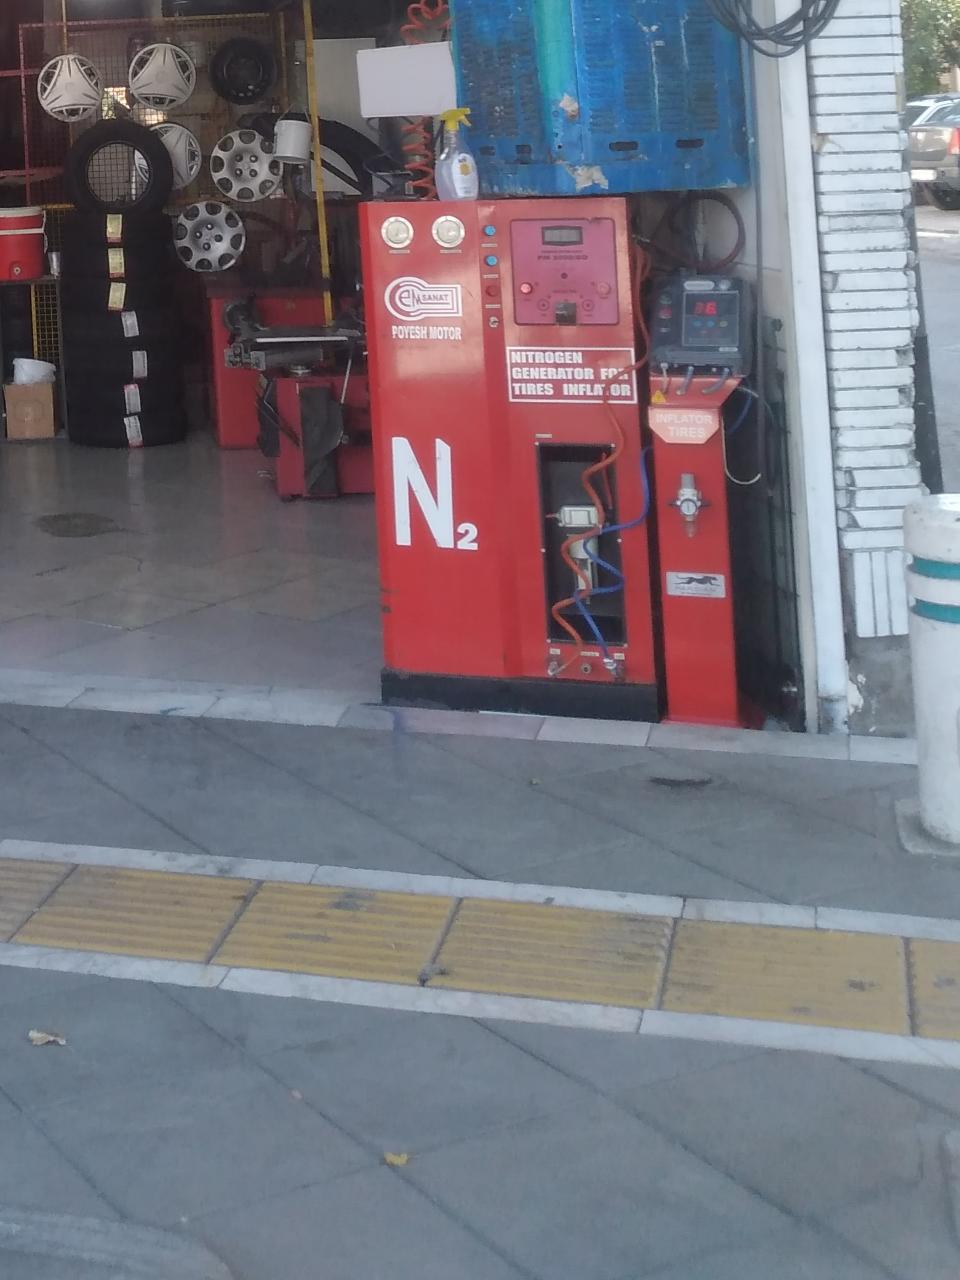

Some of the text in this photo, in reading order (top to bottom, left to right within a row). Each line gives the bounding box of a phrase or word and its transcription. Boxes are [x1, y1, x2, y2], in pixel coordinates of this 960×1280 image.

[392, 325, 461, 340] POYESH MOTOR
[511, 352, 582, 363] NITROGEN
[512, 367, 594, 380] GENERATOR
[512, 383, 554, 395] TIRES
[655, 413, 713, 425] INFLATOR
[667, 426, 707, 438] TIRES
